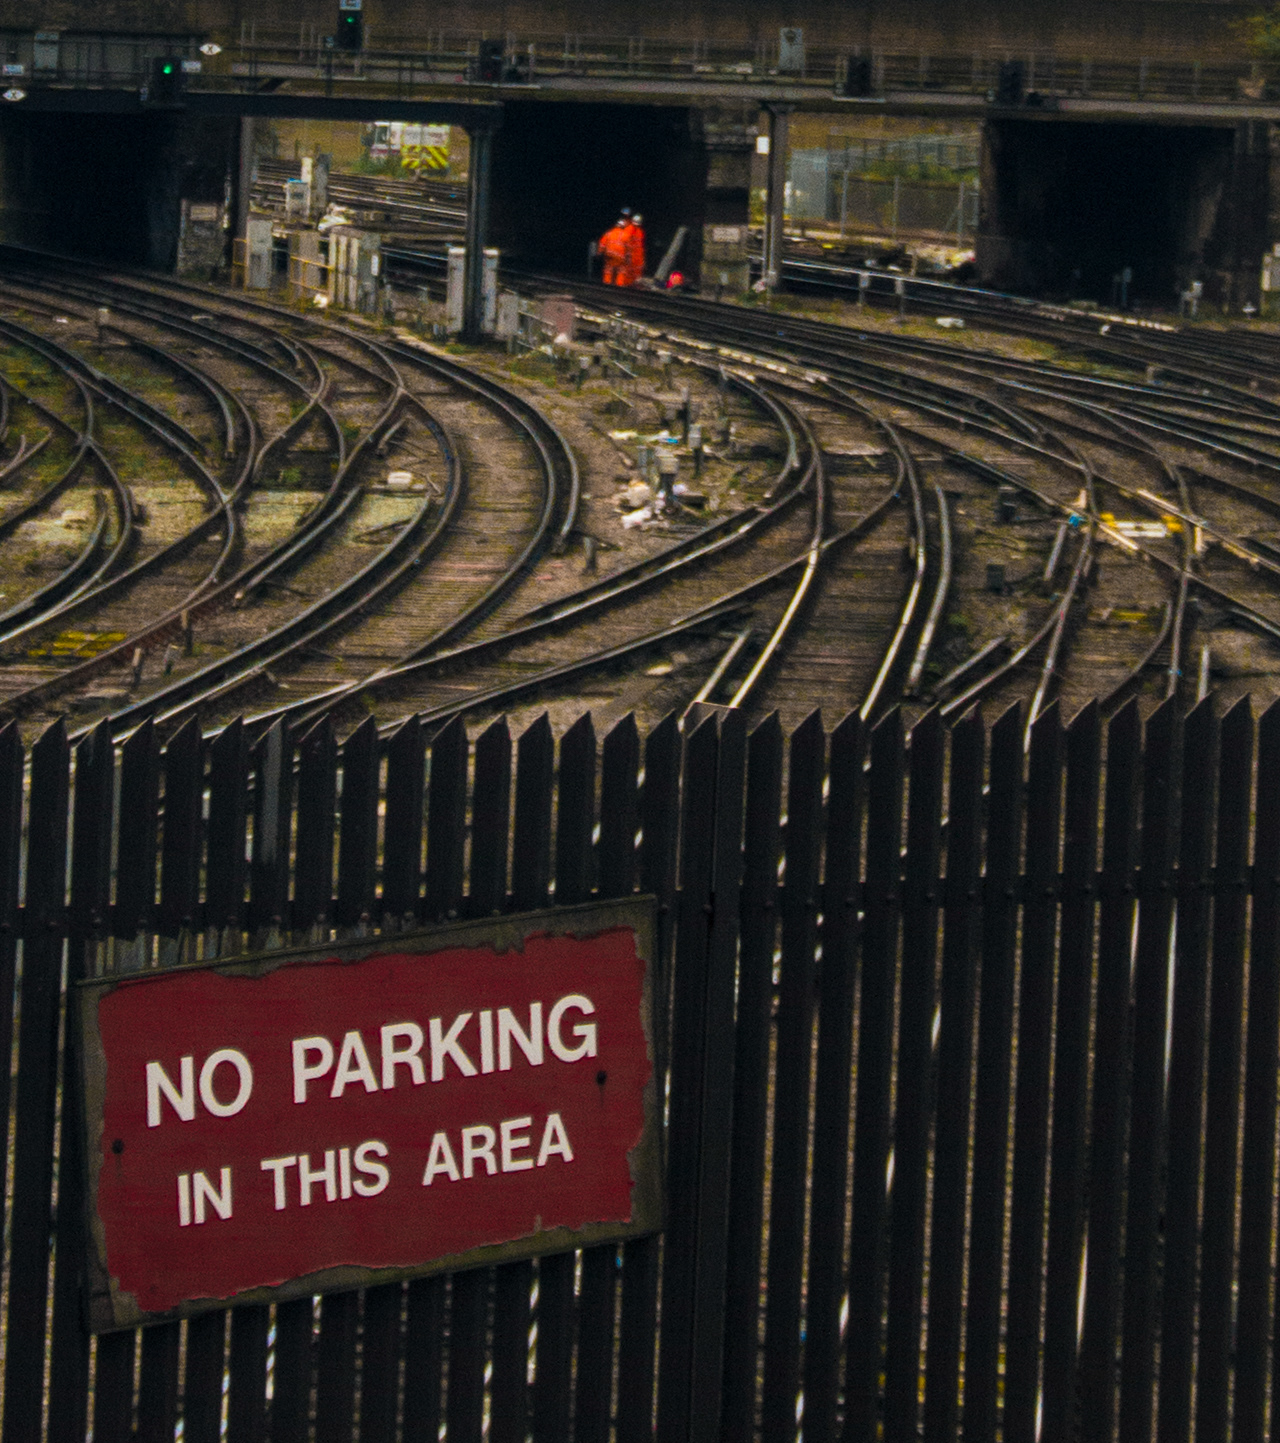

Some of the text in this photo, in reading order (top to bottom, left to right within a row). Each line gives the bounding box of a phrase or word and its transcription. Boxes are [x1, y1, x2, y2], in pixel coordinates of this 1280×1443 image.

[145, 993, 598, 1127] NO PARKING
[177, 1112, 574, 1227] IN THIS AREA
